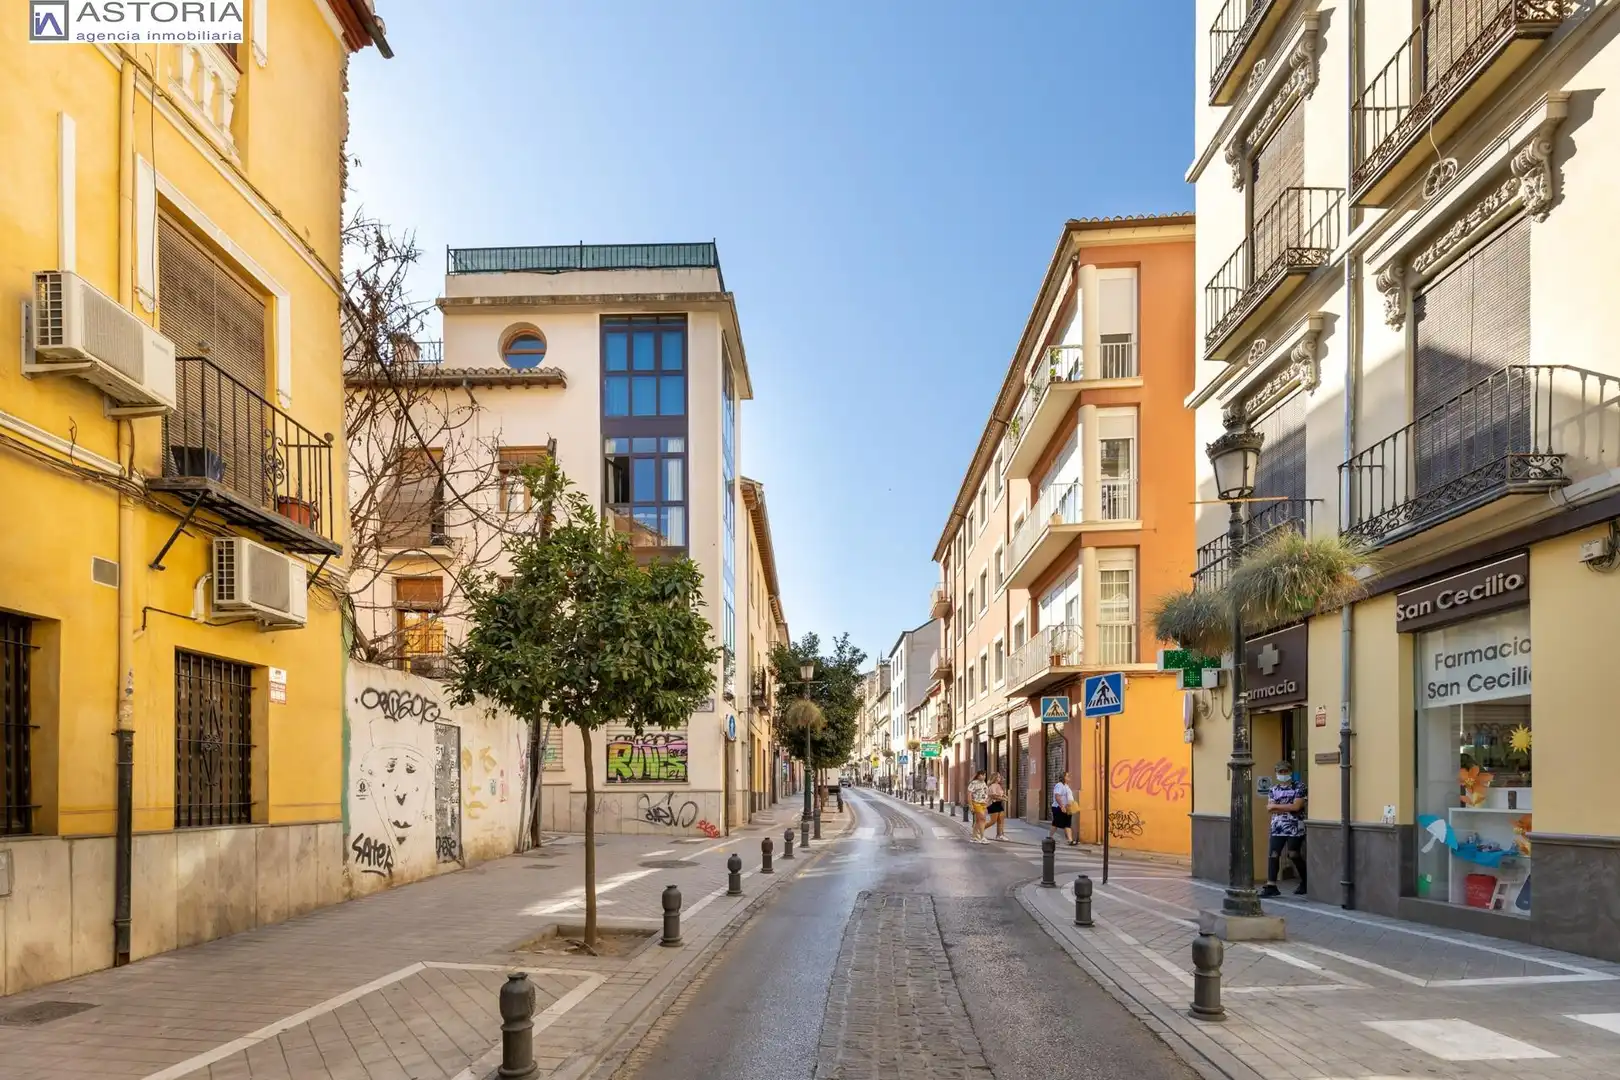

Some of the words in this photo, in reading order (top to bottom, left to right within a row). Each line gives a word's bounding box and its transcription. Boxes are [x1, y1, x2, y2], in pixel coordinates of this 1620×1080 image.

[1396, 600, 1431, 621] San
[1436, 573, 1521, 609] Cecilio
[1246, 679, 1296, 700] armacia
[1428, 681, 1460, 699] San
[1467, 666, 1531, 692] Cecili
